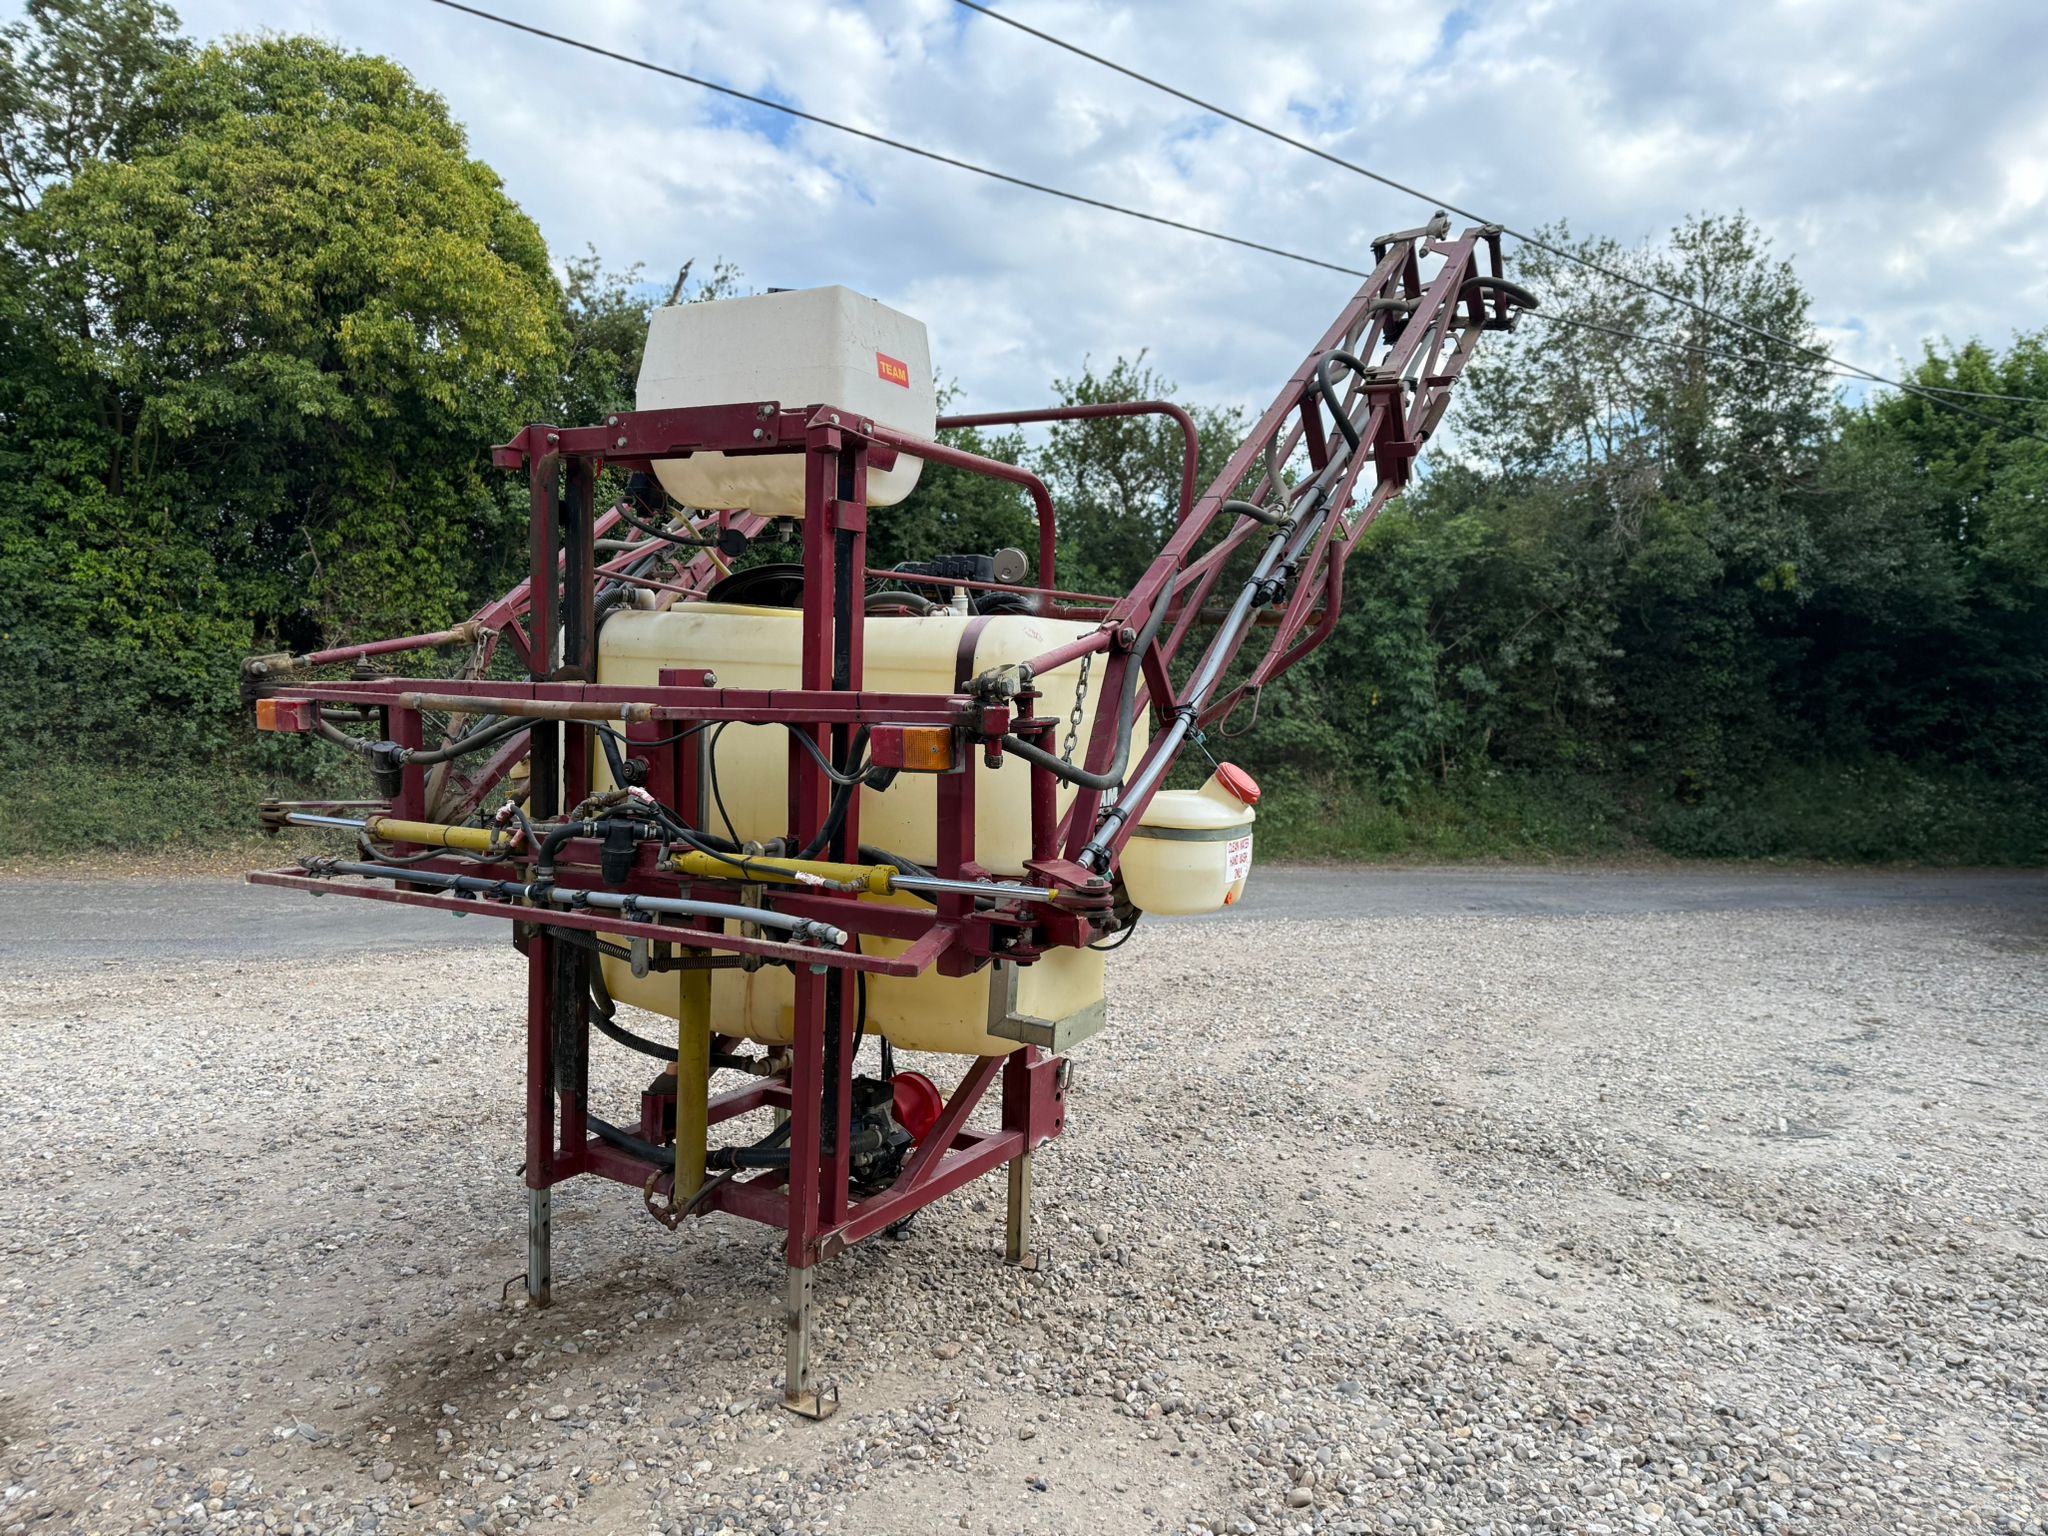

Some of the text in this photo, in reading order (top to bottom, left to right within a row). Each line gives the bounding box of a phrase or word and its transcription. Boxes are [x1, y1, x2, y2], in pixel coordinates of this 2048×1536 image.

[879, 361, 906, 382] TEAM
[1228, 838, 1249, 854] CLEAN WATER
[1229, 854, 1238, 868] HAND
